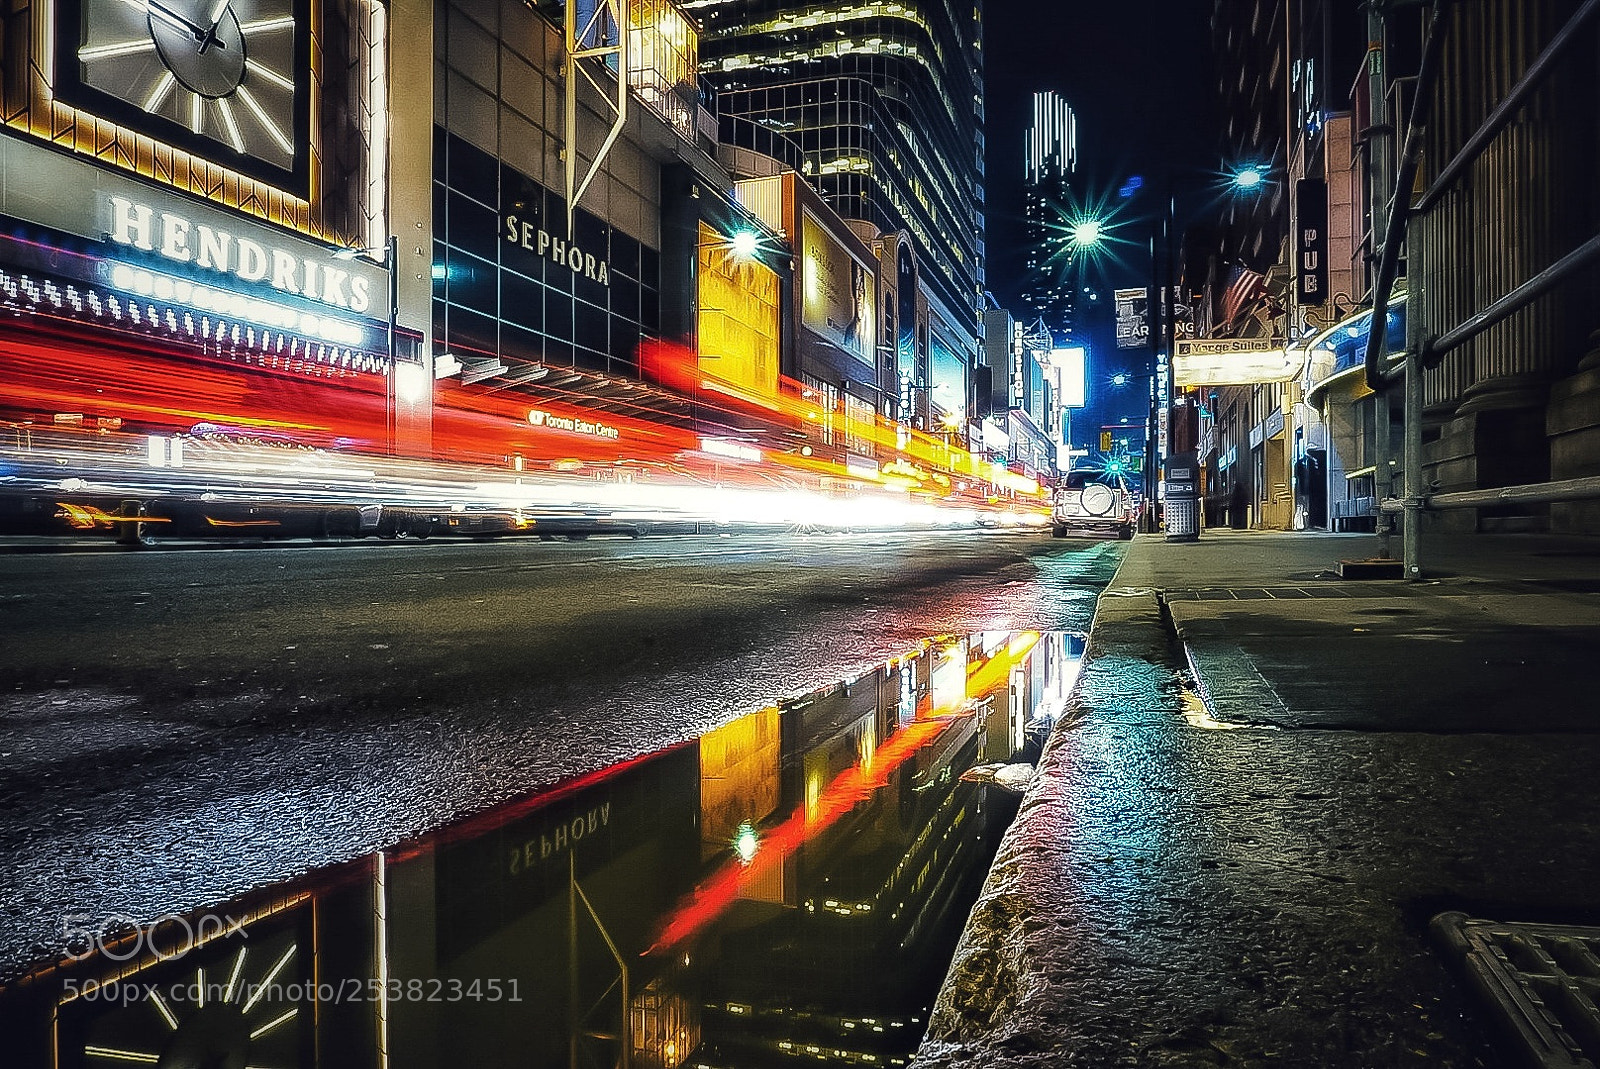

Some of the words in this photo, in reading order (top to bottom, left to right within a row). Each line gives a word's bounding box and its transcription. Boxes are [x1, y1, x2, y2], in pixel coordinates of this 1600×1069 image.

[111, 196, 370, 312] HENDRIKS
[505, 214, 609, 286] SEPHORA
[1304, 229, 1318, 293] PUB
[1231, 341, 1268, 351] Suites
[544, 412, 574, 431] Toronto
[574, 418, 595, 434] Eaton
[595, 422, 619, 439] Centre
